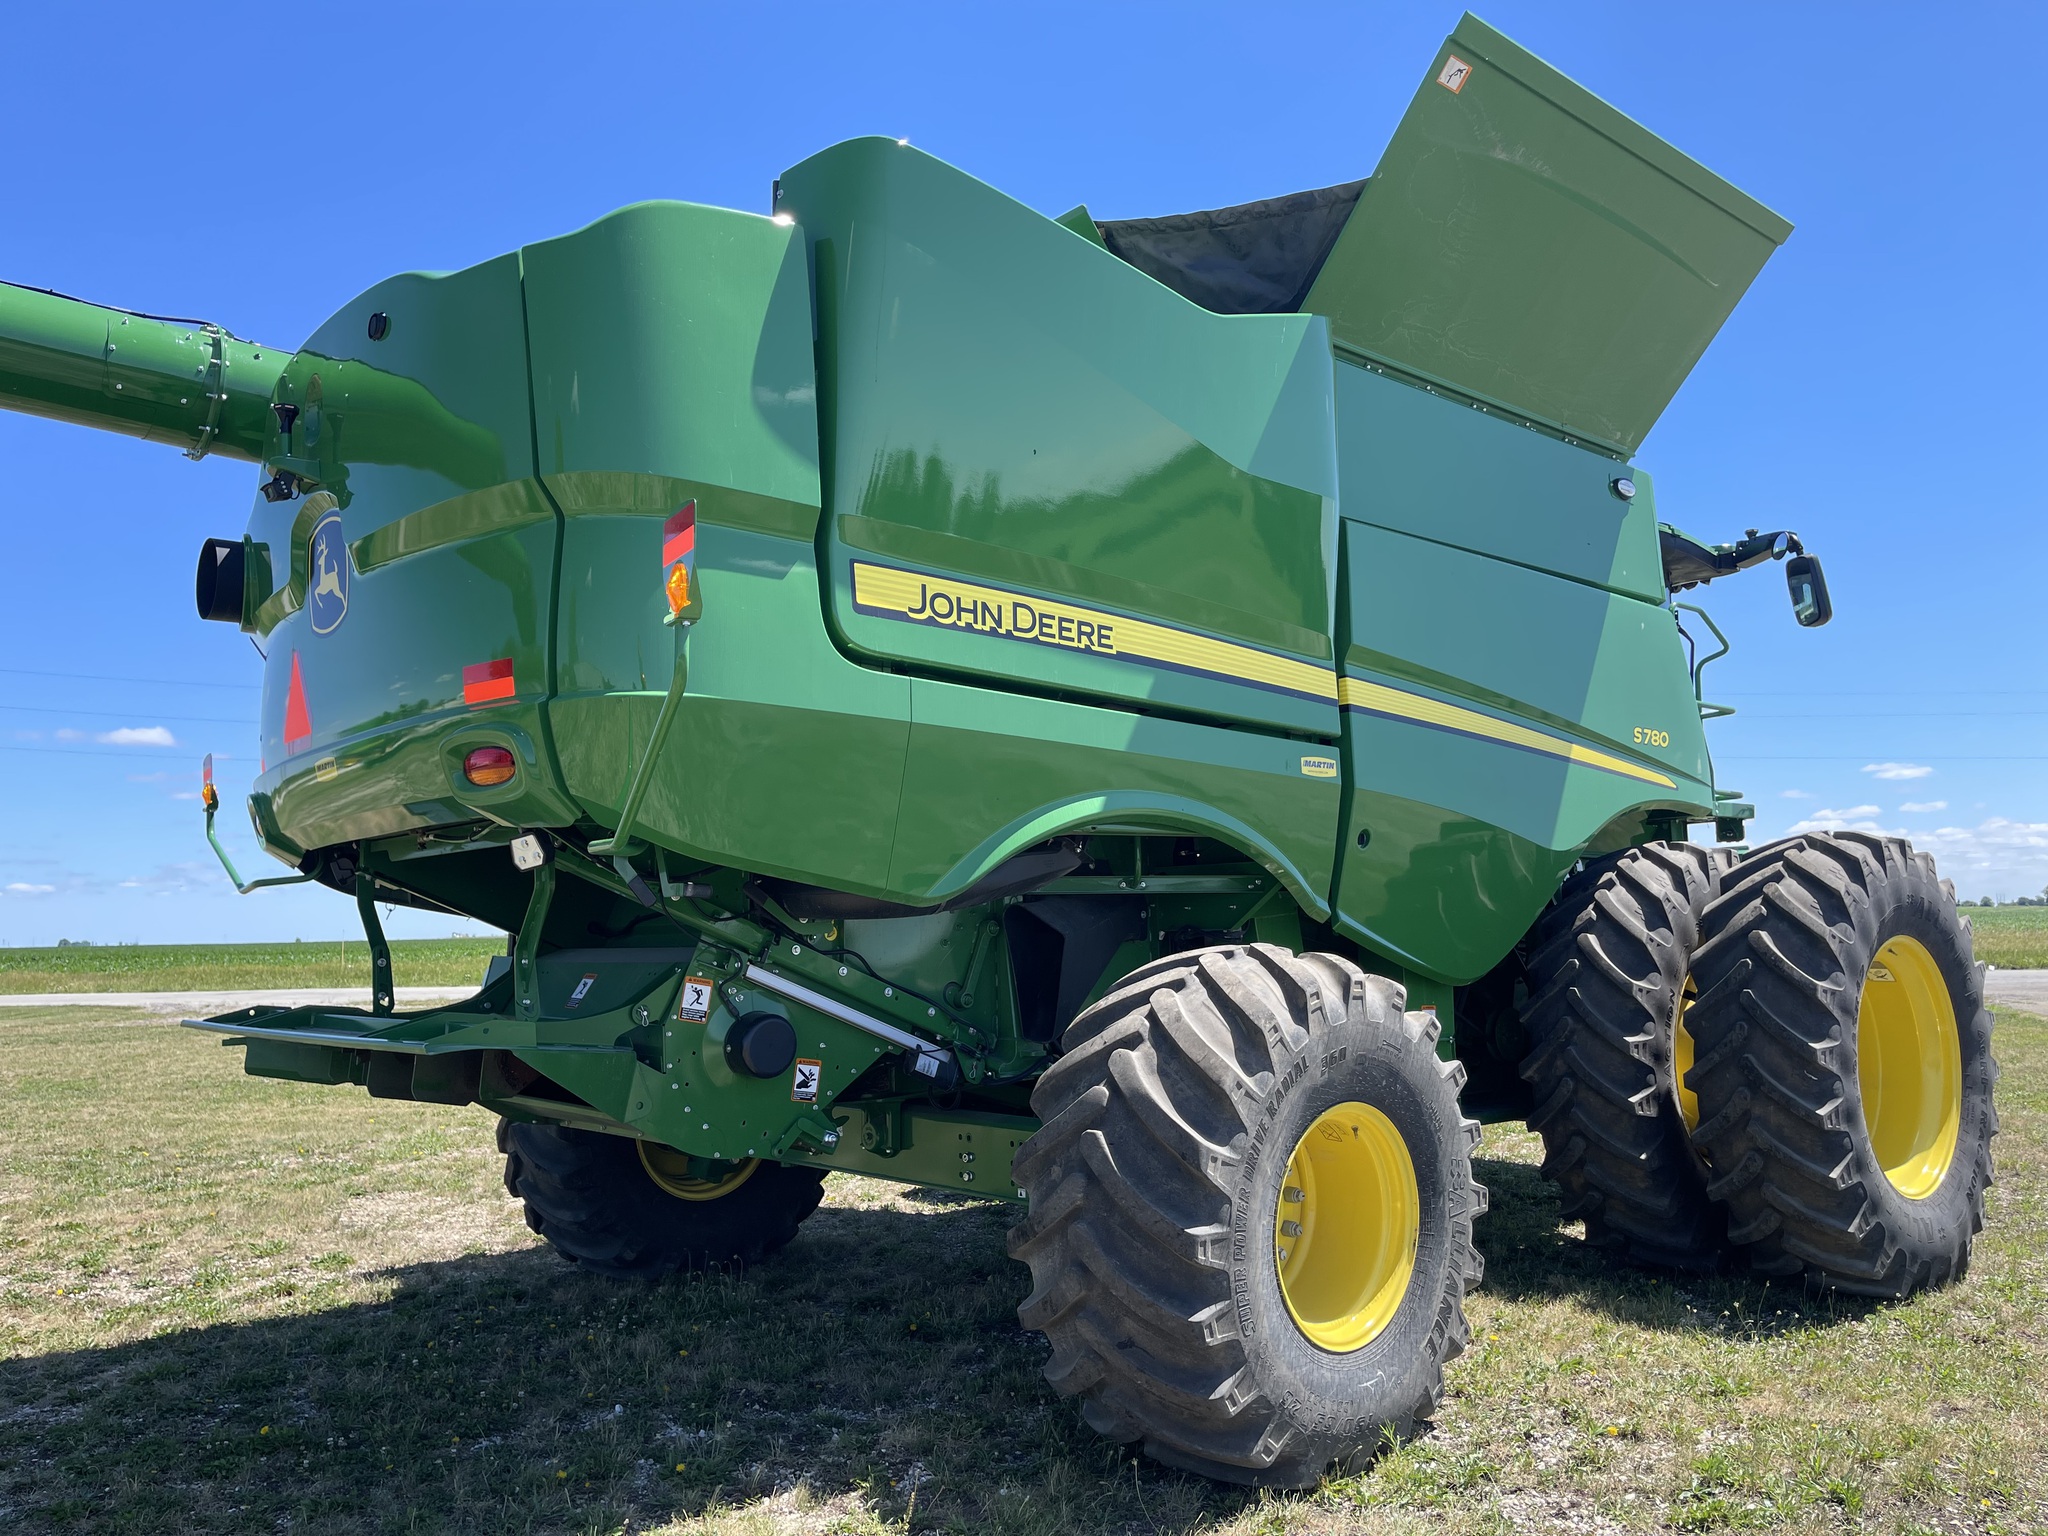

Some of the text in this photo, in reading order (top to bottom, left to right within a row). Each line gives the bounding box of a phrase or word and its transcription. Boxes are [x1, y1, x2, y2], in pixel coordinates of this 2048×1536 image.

[908, 583, 1114, 650] JOHN DEERE
[1304, 760, 1335, 769] MARTIN
[1633, 726, 1670, 748] S780
[1265, 1053, 1310, 1120] RADIAL
[1242, 1119, 1269, 1183] DRIVE
[1233, 1187, 1251, 1261] POWER
[1234, 1266, 1257, 1338] SUPER
[1424, 1188, 1468, 1368] ALLIANCE
